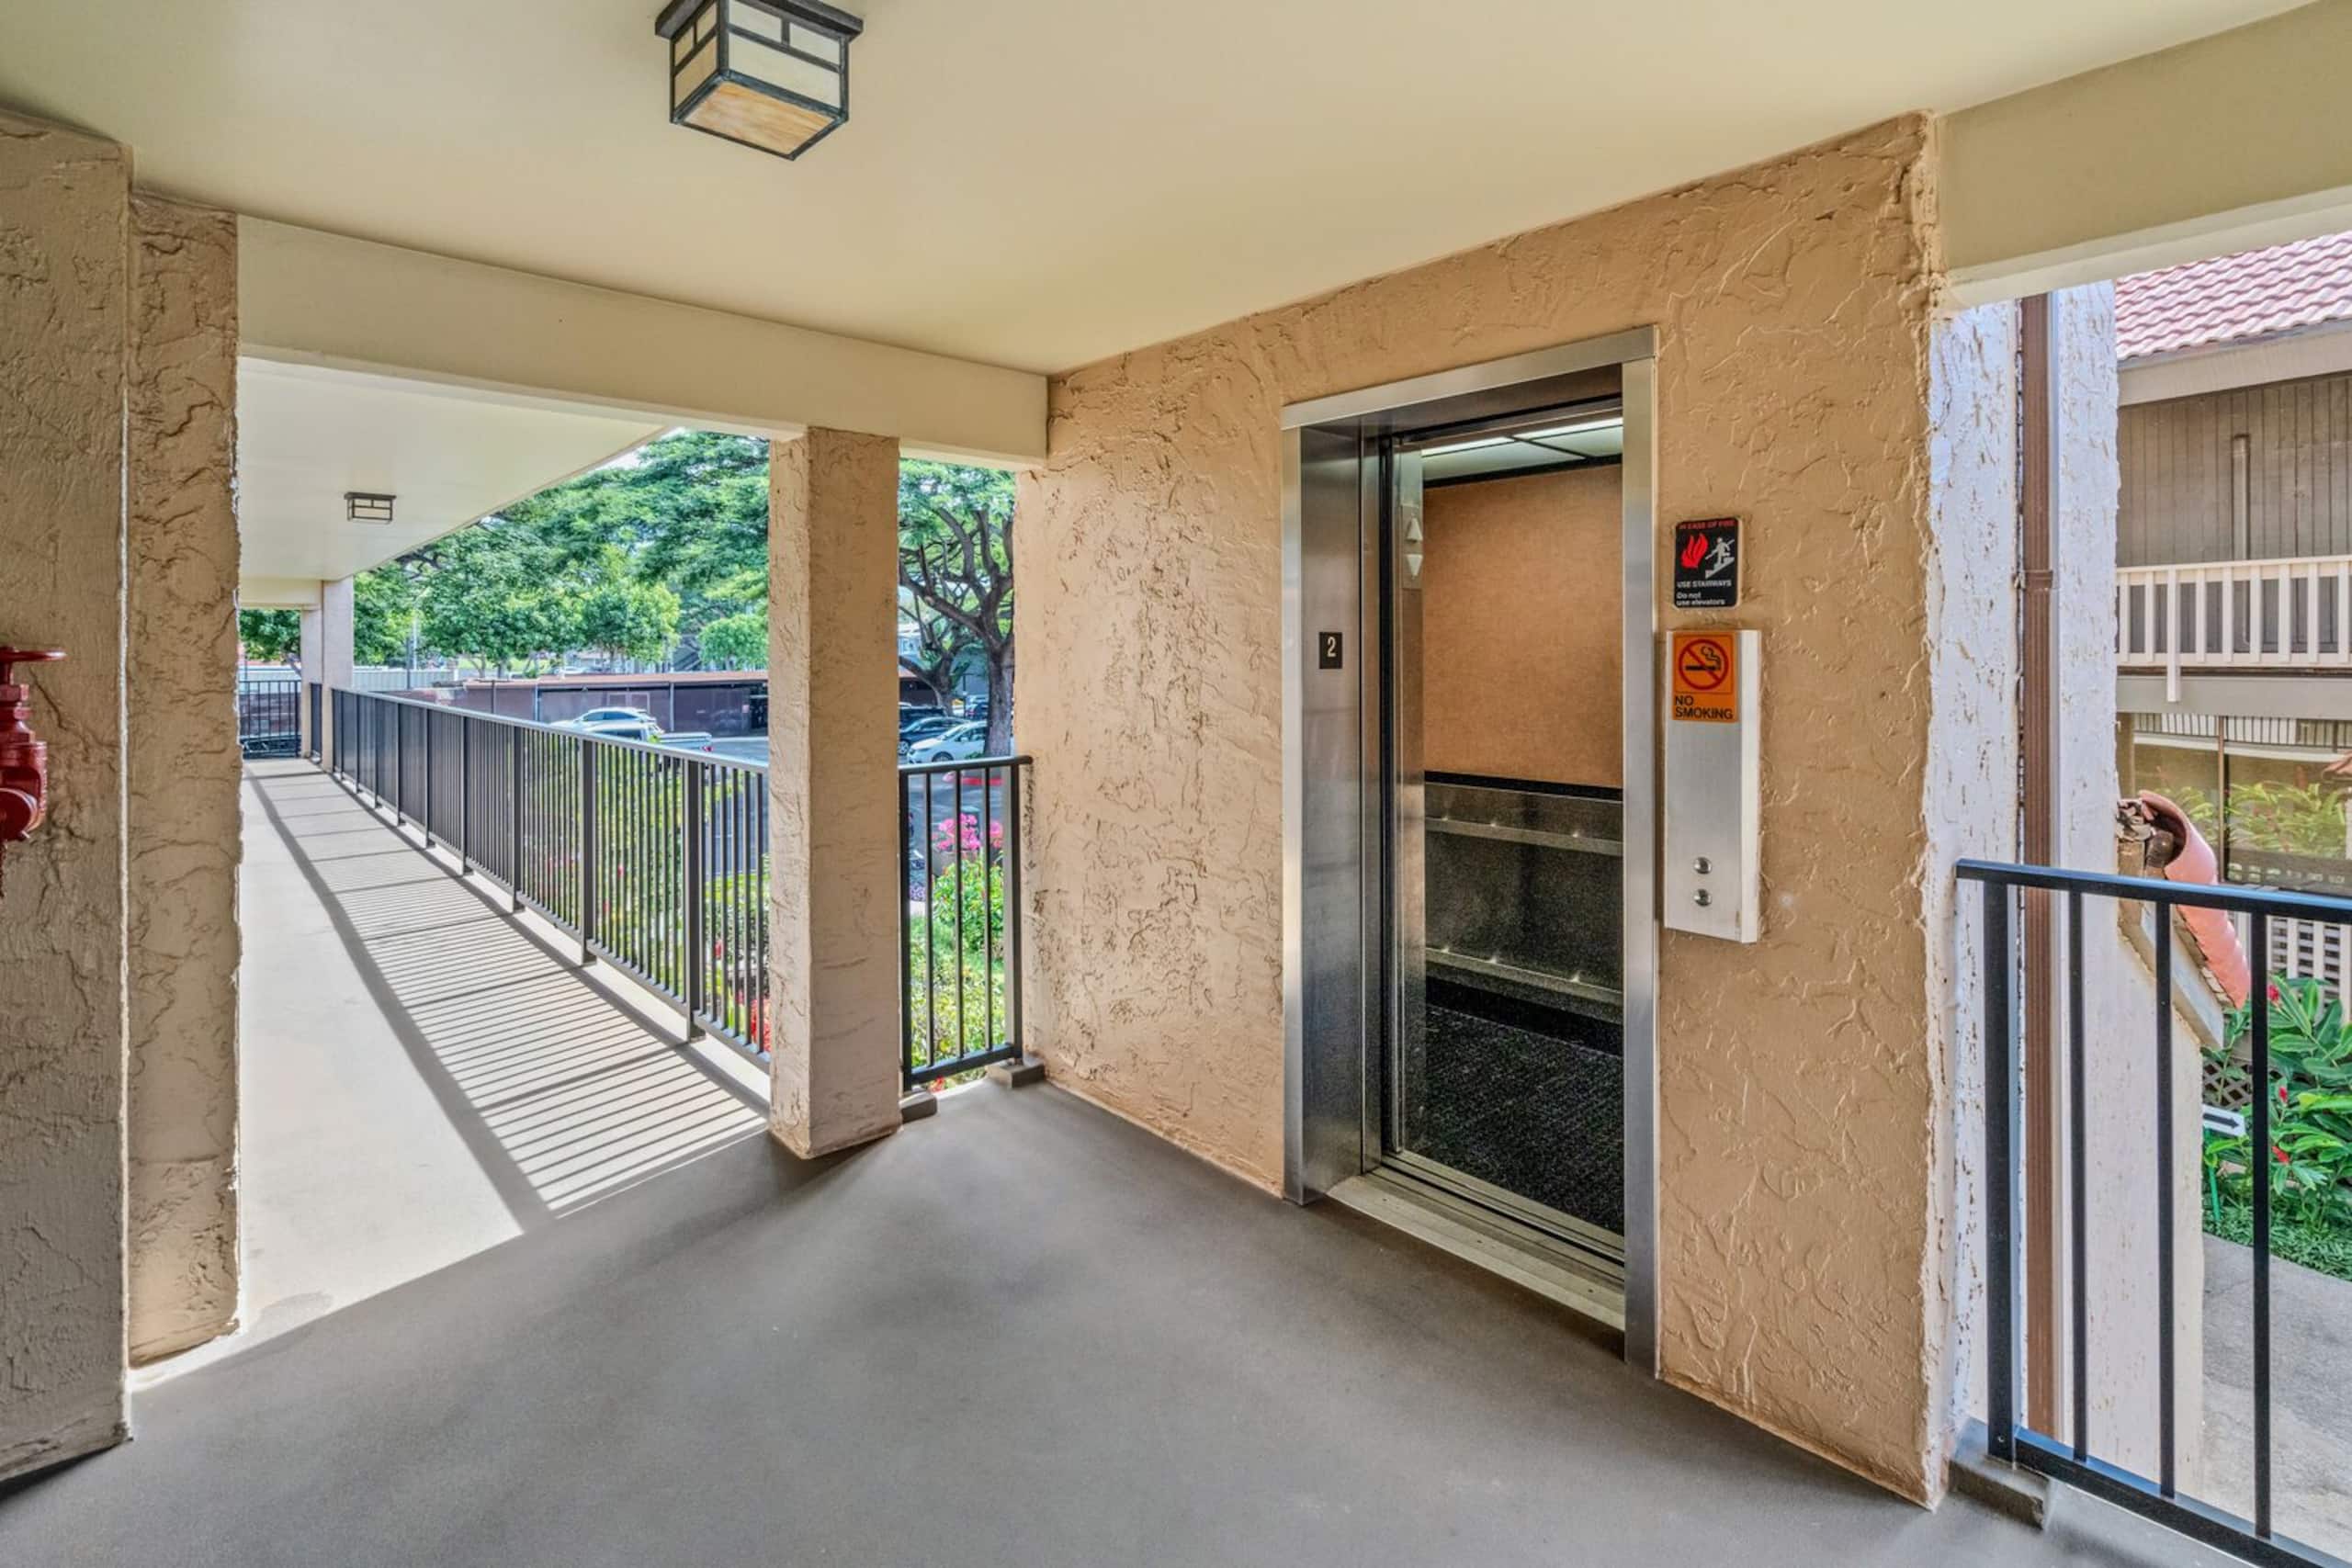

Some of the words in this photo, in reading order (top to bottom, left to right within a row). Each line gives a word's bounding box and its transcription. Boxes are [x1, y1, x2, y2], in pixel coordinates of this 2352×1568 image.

[1692, 580, 1732, 588] STAIRWAYS
[1327, 636, 1337, 658] 2
[1675, 695, 1694, 706] NO
[1675, 706, 1734, 720] SMOKING
